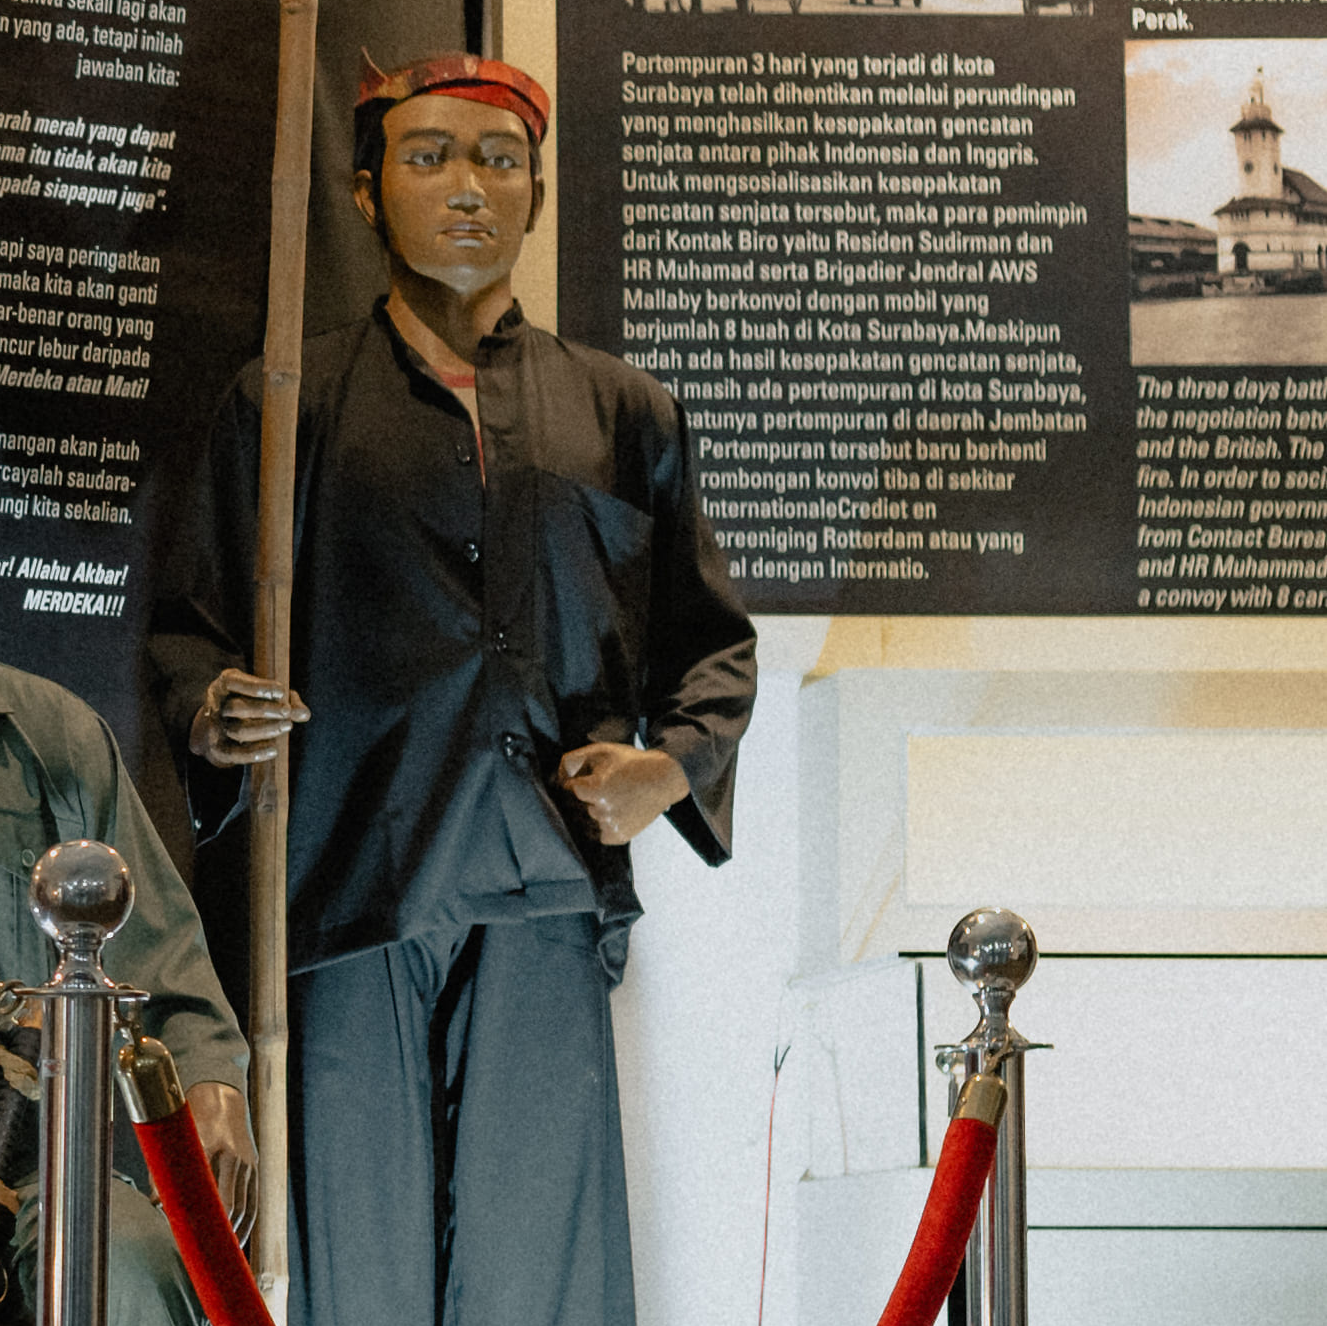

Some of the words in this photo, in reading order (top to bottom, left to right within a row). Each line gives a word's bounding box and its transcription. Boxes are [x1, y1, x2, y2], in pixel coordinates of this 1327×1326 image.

[75, 57, 144, 82] jawaban
[147, 61, 180, 87] kita:
[622, 51, 748, 78] Pertempuran
[752, 52, 765, 75] 3
[768, 51, 807, 75] hari
[810, 57, 859, 80] yang
[863, 52, 926, 80] terjadi
[930, 53, 948, 76] di
[953, 53, 995, 76] kota
[622, 141, 693, 167] senjata
[698, 143, 761, 163] antara
[767, 141, 820, 168] pihak
[824, 142, 919, 164] Indonesia
[924, 142, 961, 164] dan
[966, 143, 1039, 169] Inggris.
[43, 176, 118, 208] siapapun
[26, 243, 64, 267] saya
[68, 245, 160, 274] peringatkan
[623, 259, 652, 280] HR
[656, 259, 754, 281] Muhamad
[759, 261, 809, 282] serta
[815, 259, 905, 286] Brigadier
[909, 259, 984, 282] Jendral
[988, 259, 1038, 283] AWS
[623, 288, 702, 315] Mallaby
[706, 289, 801, 312] berkonvoi
[806, 290, 879, 316] dengan
[884, 290, 937, 312] mobil
[941, 294, 989, 317] yang
[65, 374, 103, 395] atau
[104, 374, 150, 399] Mati!
[1136, 435, 1175, 459] and
[1178, 435, 1210, 459] the
[1289, 435, 1323, 460] The
[15, 557, 71, 582] Allahu
[71, 561, 129, 586] Akbar!
[23, 588, 126, 618] MERDEKA!!!
